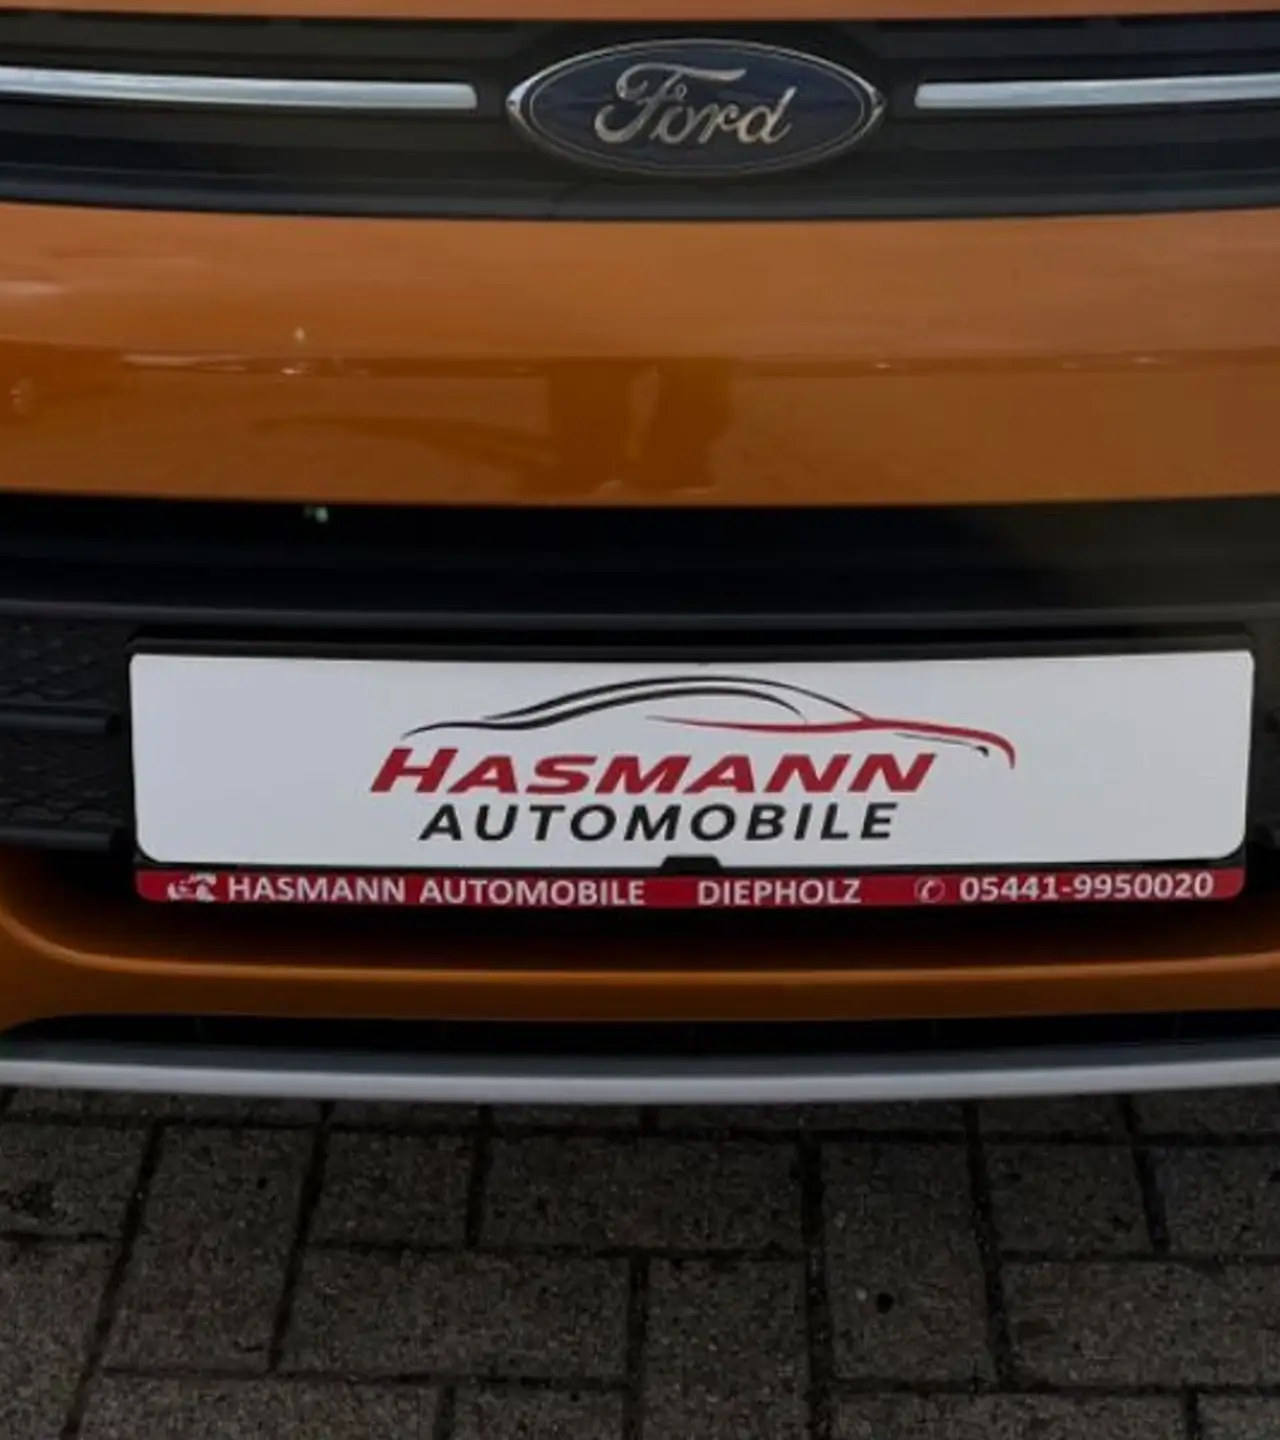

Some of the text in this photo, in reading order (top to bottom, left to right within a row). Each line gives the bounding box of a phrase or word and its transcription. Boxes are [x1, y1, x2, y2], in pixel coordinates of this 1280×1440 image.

[593, 61, 797, 145] Ford
[369, 747, 938, 795] HASMANN
[418, 801, 899, 842] AUTOMOBILE
[227, 871, 1215, 907] HASMANN AUTOMOBILE DIEPHOLZ 05441-9950020
